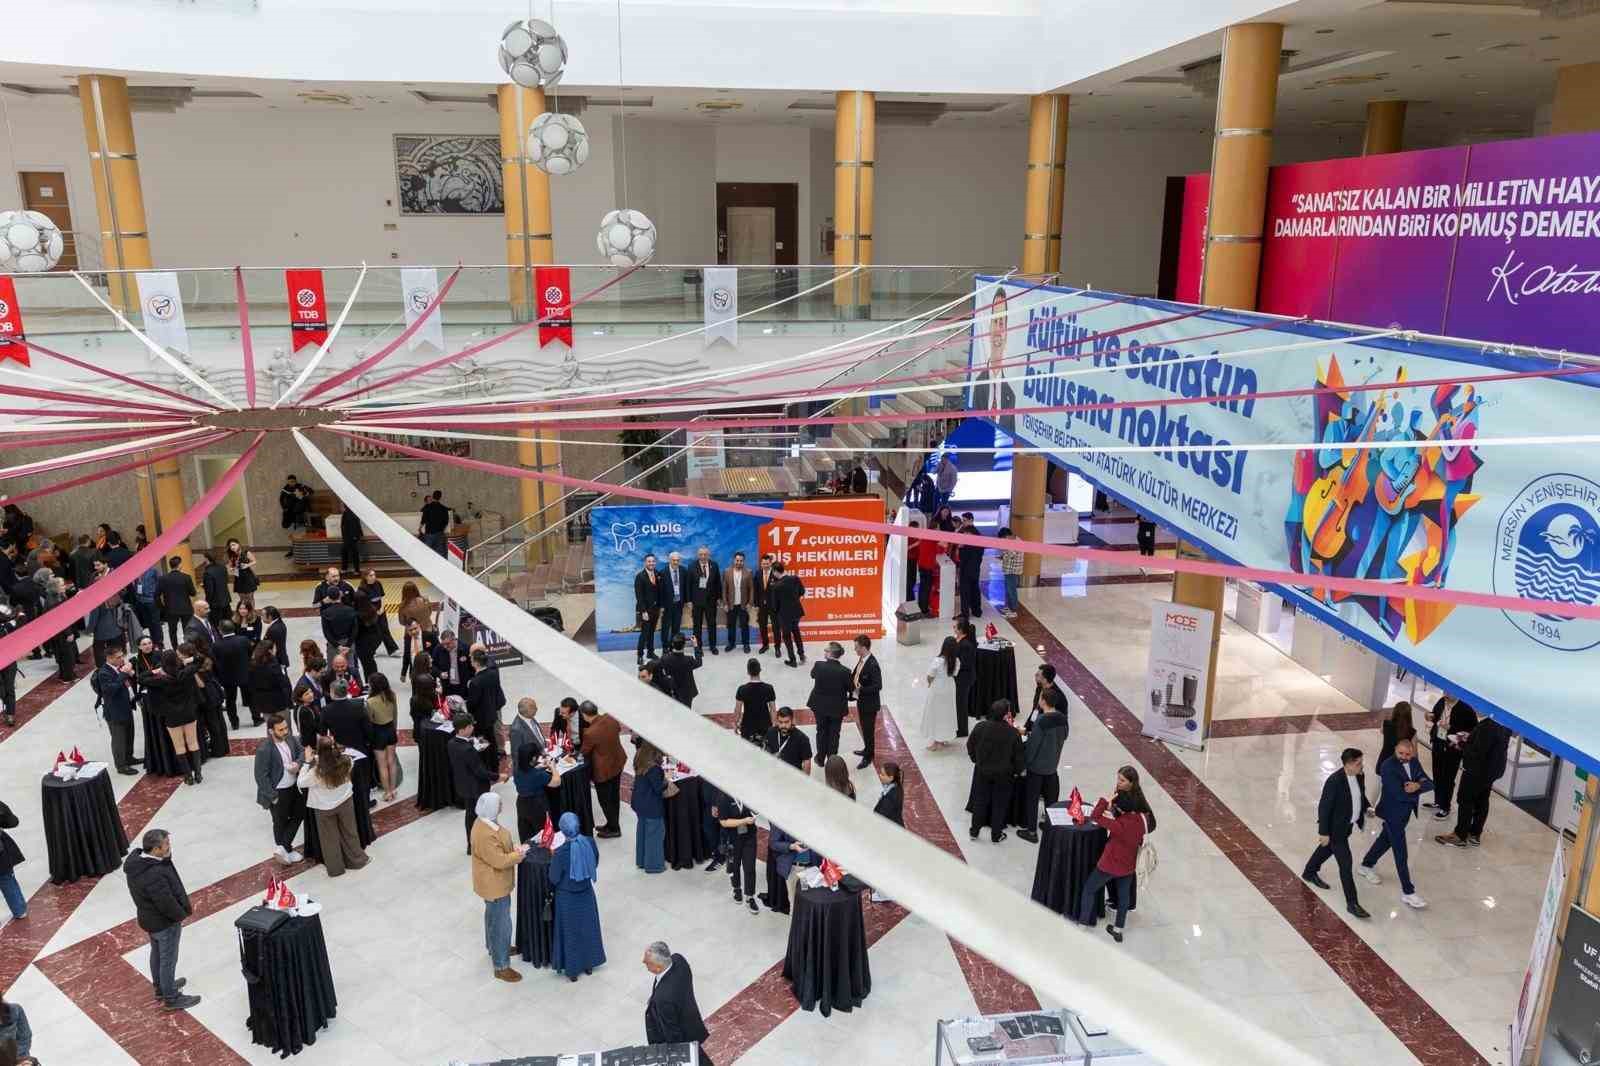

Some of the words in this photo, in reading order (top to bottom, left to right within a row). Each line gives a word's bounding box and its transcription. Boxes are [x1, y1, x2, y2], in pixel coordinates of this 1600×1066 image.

[1362, 186, 1421, 211] KALAN
[1546, 175, 1600, 204] HAY
[1274, 214, 1396, 238] DAMARLARINDAN
[1431, 210, 1519, 244] KOPMUŞ
[298, 310, 320, 319] TDB
[1026, 306, 1088, 361] kültür
[1092, 330, 1121, 373] ve
[1125, 339, 1258, 419] sanatın
[1022, 354, 1116, 434] buluşma
[1117, 400, 1249, 495] noktası
[1095, 450, 1138, 488] ATATÜRK
[1137, 470, 1179, 506] KÜLTÜR
[808, 534, 878, 548] ÇUKUROVA
[796, 547, 878, 563] HEKİMLERİ
[819, 565, 878, 577] KONGRESİ
[800, 584, 854, 600] ERSİN
[1530, 619, 1561, 641] 1994
